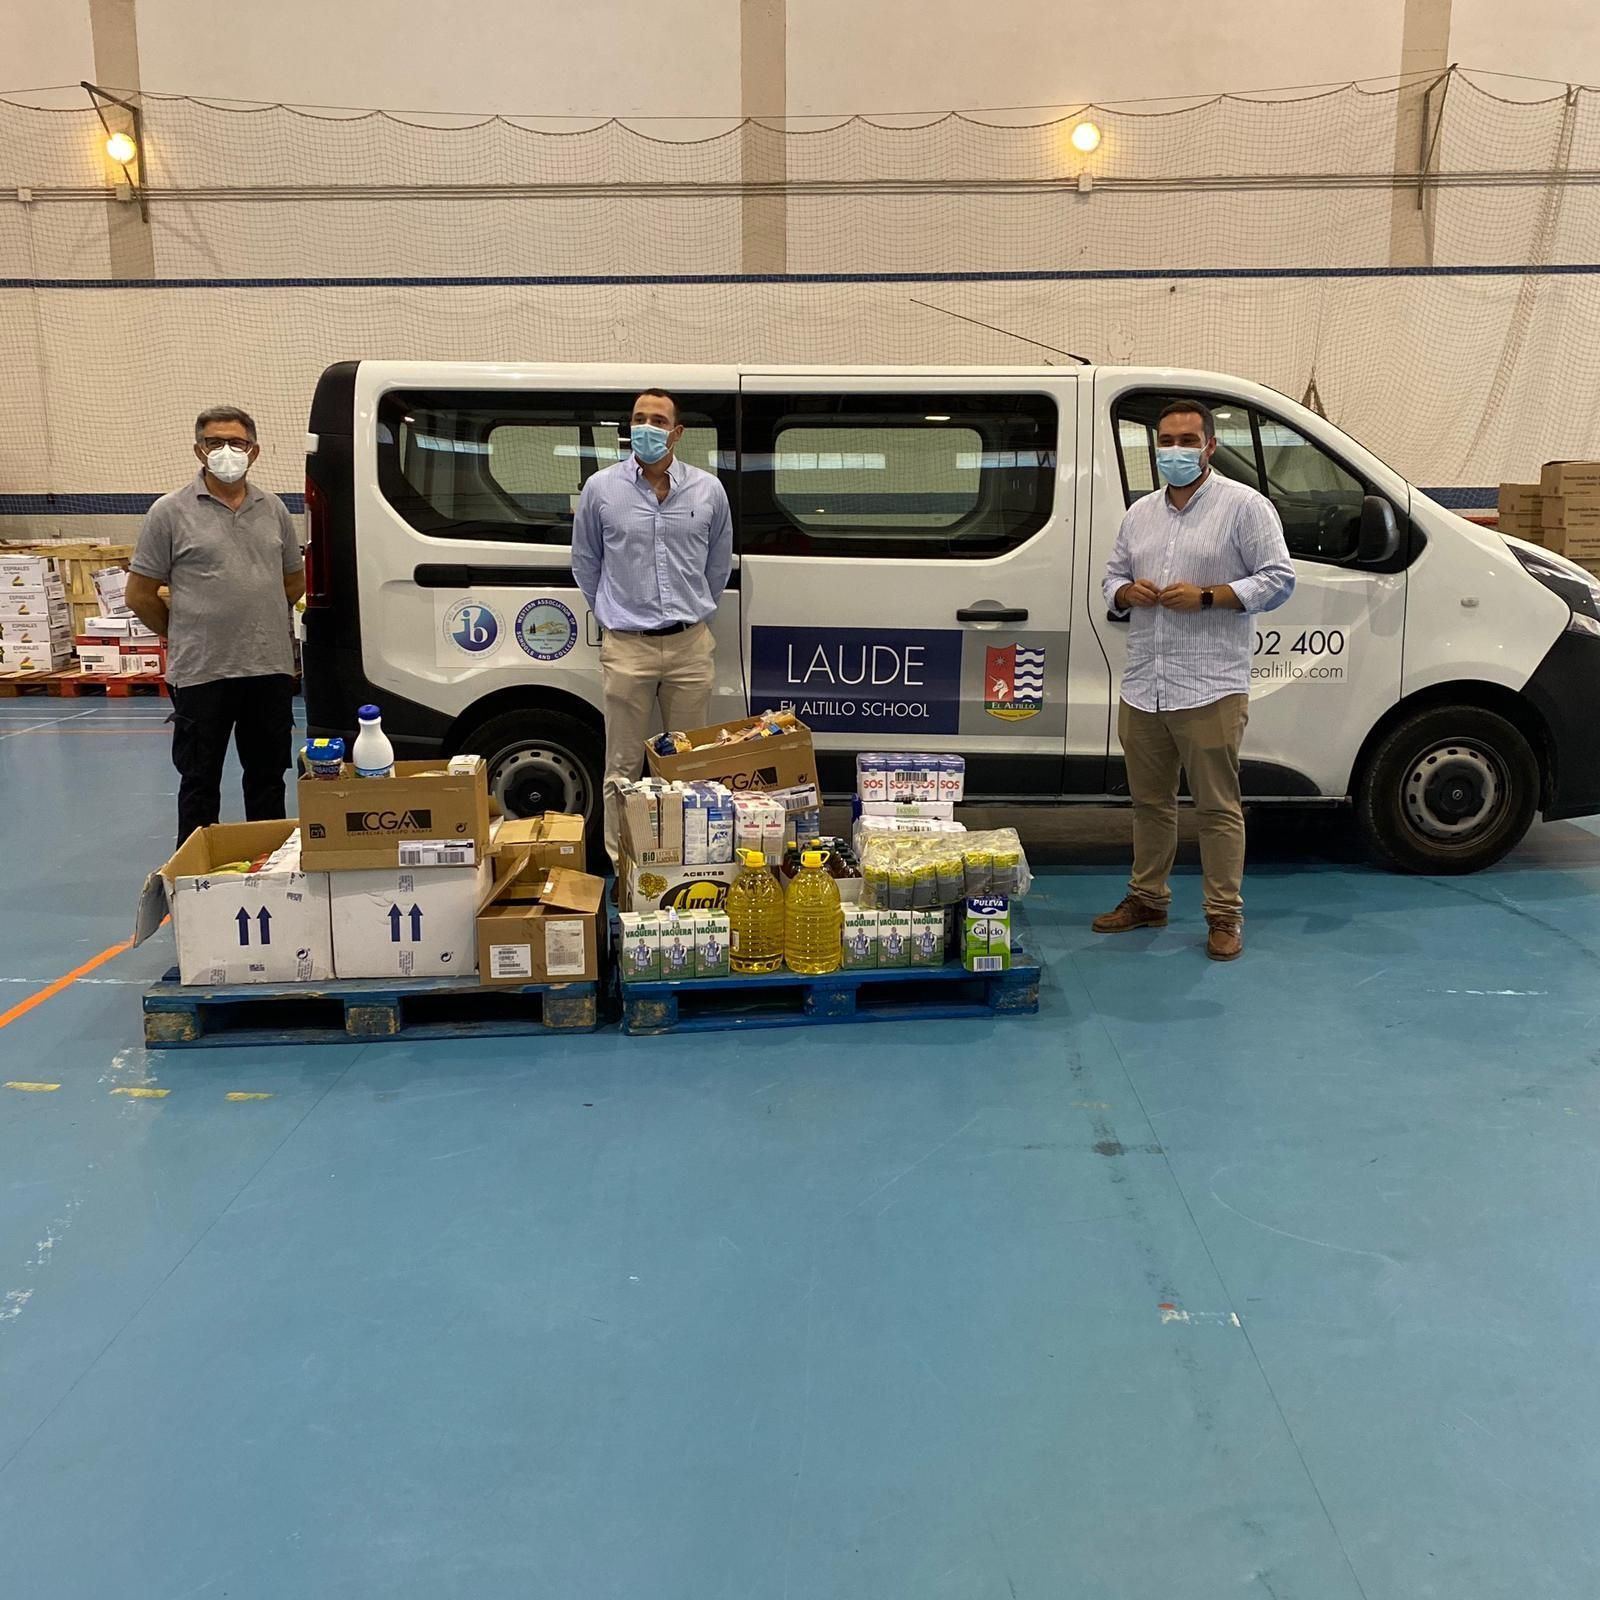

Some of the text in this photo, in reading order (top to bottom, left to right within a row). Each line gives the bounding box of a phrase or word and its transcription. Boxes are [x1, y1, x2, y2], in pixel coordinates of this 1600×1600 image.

[1290, 630, 1345, 656] 400
[787, 643, 926, 686] LAUDE
[1250, 661, 1344, 679] ealtillo.com
[800, 701, 856, 717] ALTILLO
[861, 702, 930, 718] SCHOOL
[863, 779, 884, 789] SOS
[940, 780, 960, 790] SOS
[363, 811, 419, 831] CGA
[973, 899, 1004, 907] PULEVA
[625, 929, 657, 938] VAQUERA
[661, 928, 692, 936] VAQUERA
[696, 926, 727, 934] VAQUERA
